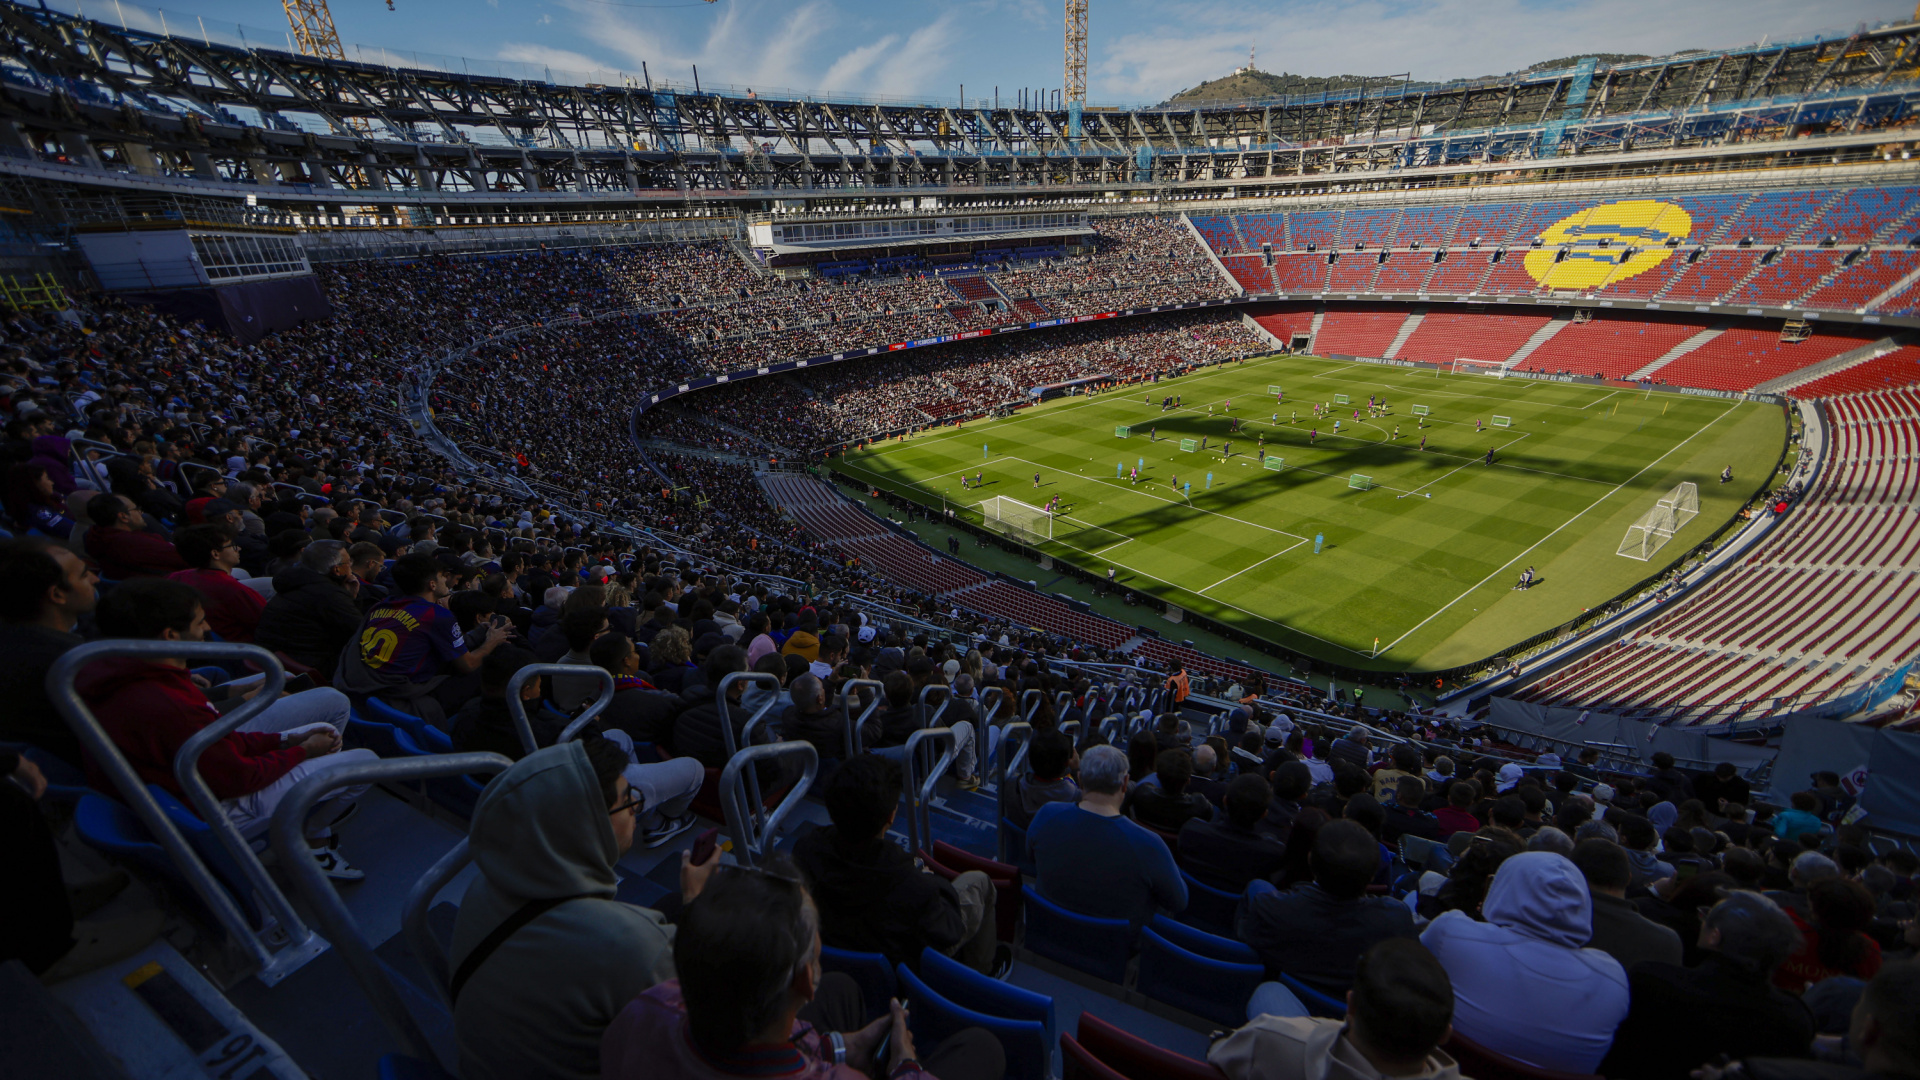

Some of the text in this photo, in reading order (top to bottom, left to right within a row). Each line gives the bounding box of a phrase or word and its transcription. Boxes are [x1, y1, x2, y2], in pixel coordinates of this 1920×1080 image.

[1680, 387, 1724, 398] DISPONIBLE
[1748, 393, 1758, 401] EL
[392, 608, 421, 632] YAMAL
[360, 626, 399, 670] 10
